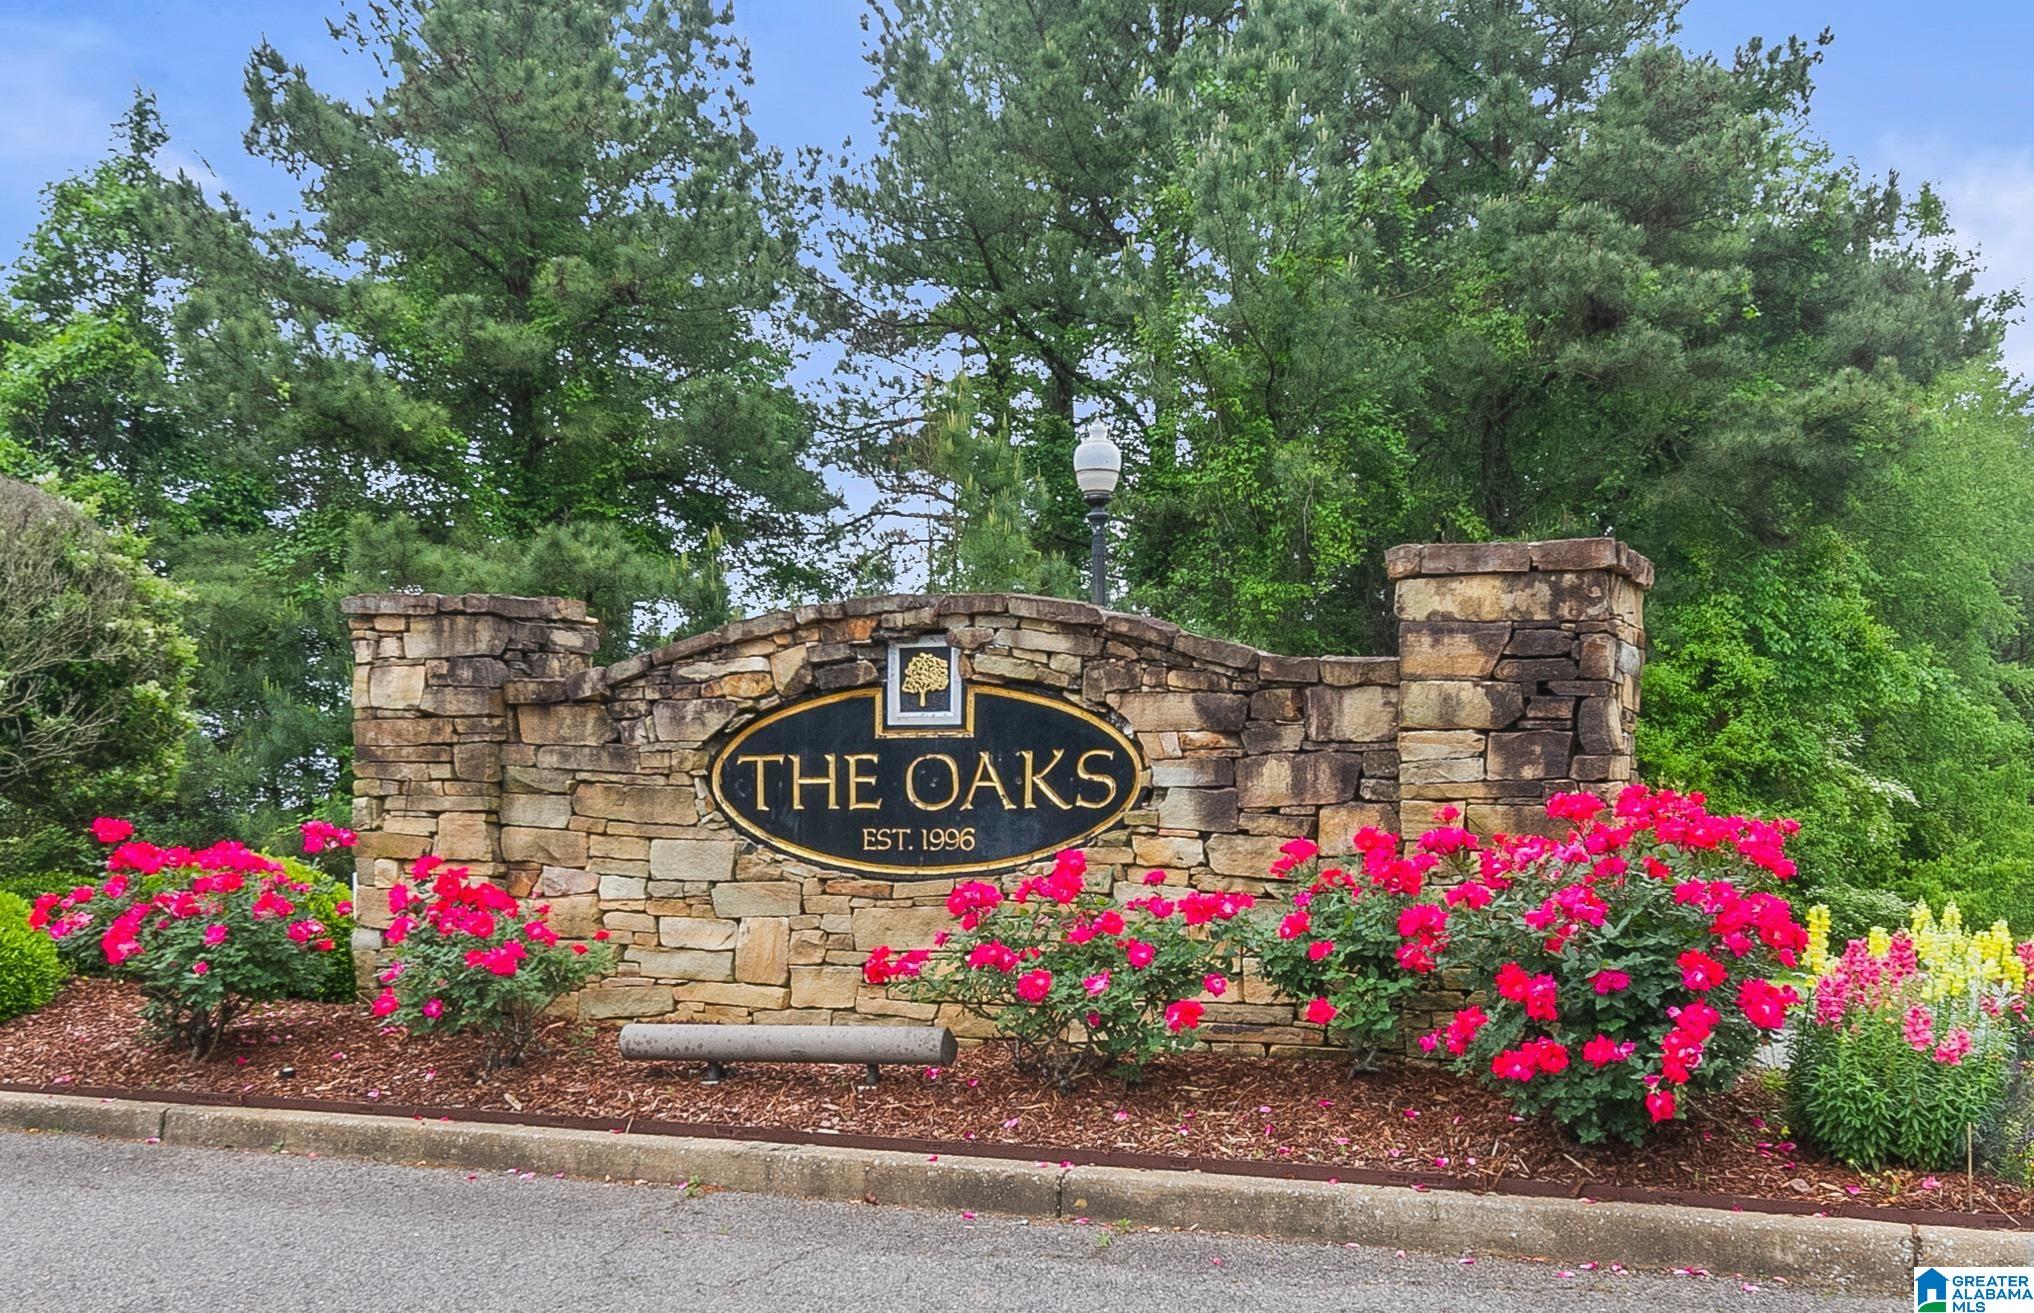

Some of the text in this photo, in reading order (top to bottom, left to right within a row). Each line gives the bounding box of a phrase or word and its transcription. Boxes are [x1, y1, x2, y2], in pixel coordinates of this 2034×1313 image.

[736, 749, 1118, 811] THE OAKS
[862, 827, 976, 852] EST. 1996
